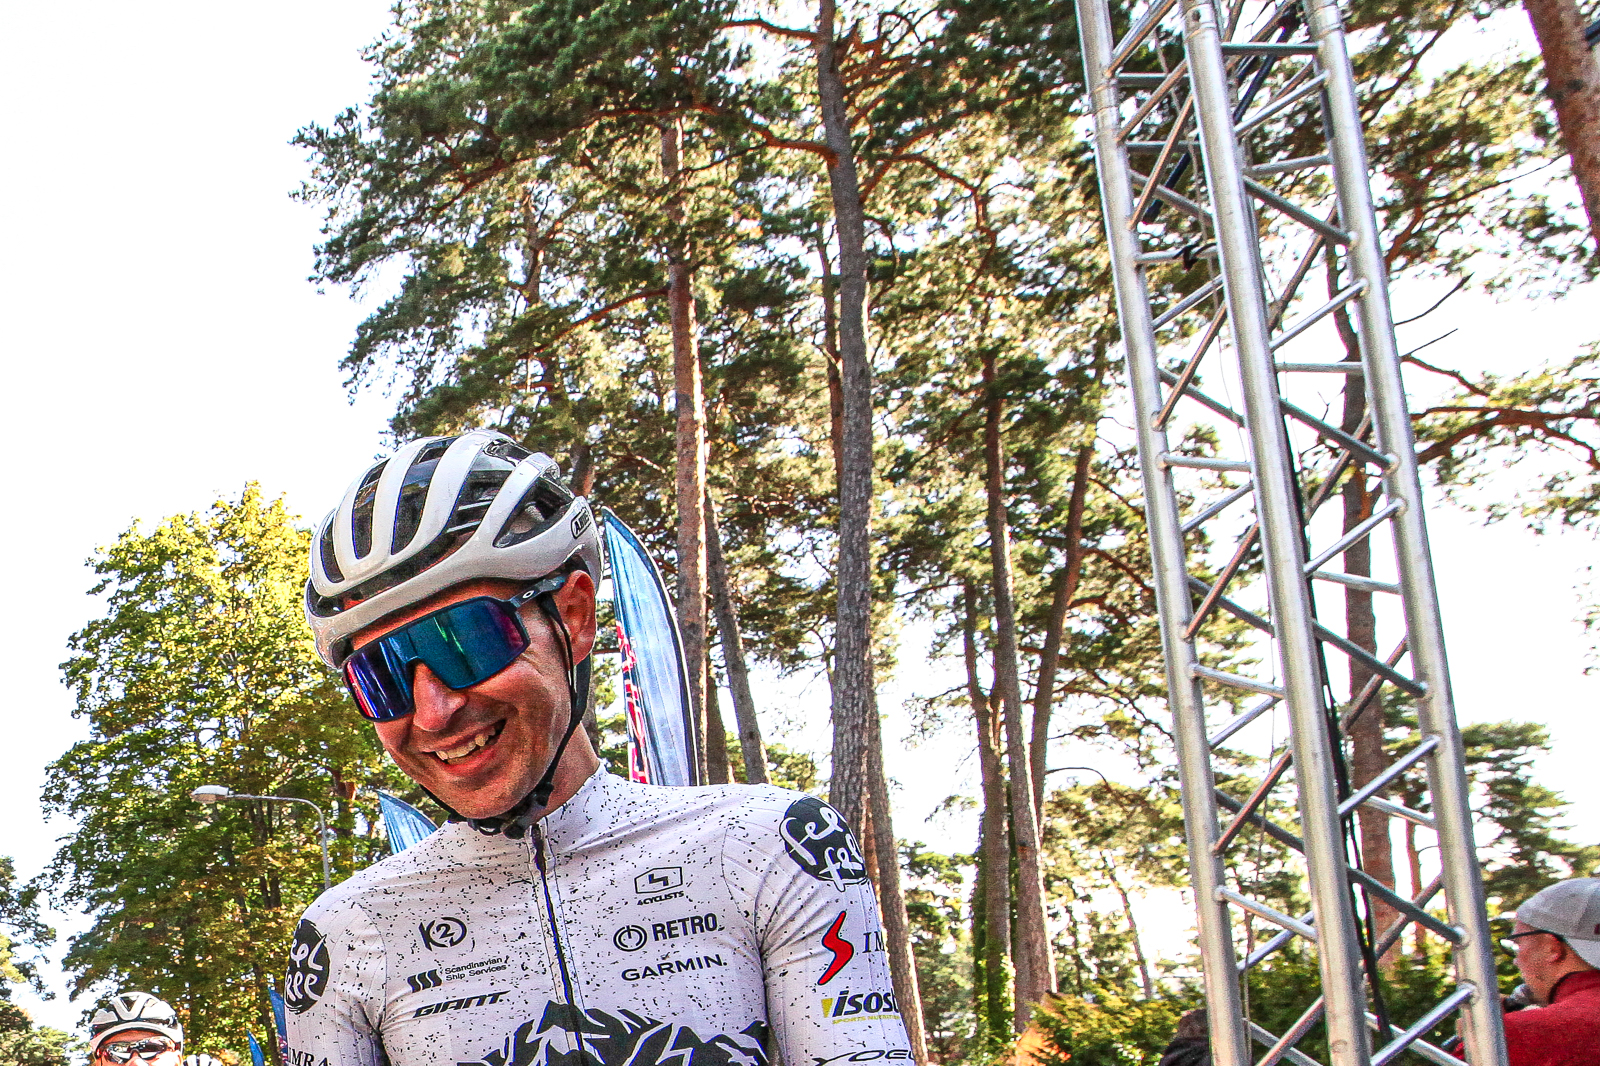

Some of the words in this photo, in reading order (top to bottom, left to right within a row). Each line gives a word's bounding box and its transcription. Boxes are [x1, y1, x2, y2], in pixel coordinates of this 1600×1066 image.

[651, 912, 718, 941] RETRO
[444, 957, 502, 974] Scandinavian
[445, 971, 466, 981] Ship
[468, 963, 507, 977] Services
[621, 953, 723, 981] GARMIN
[412, 989, 511, 1019] GIANT
